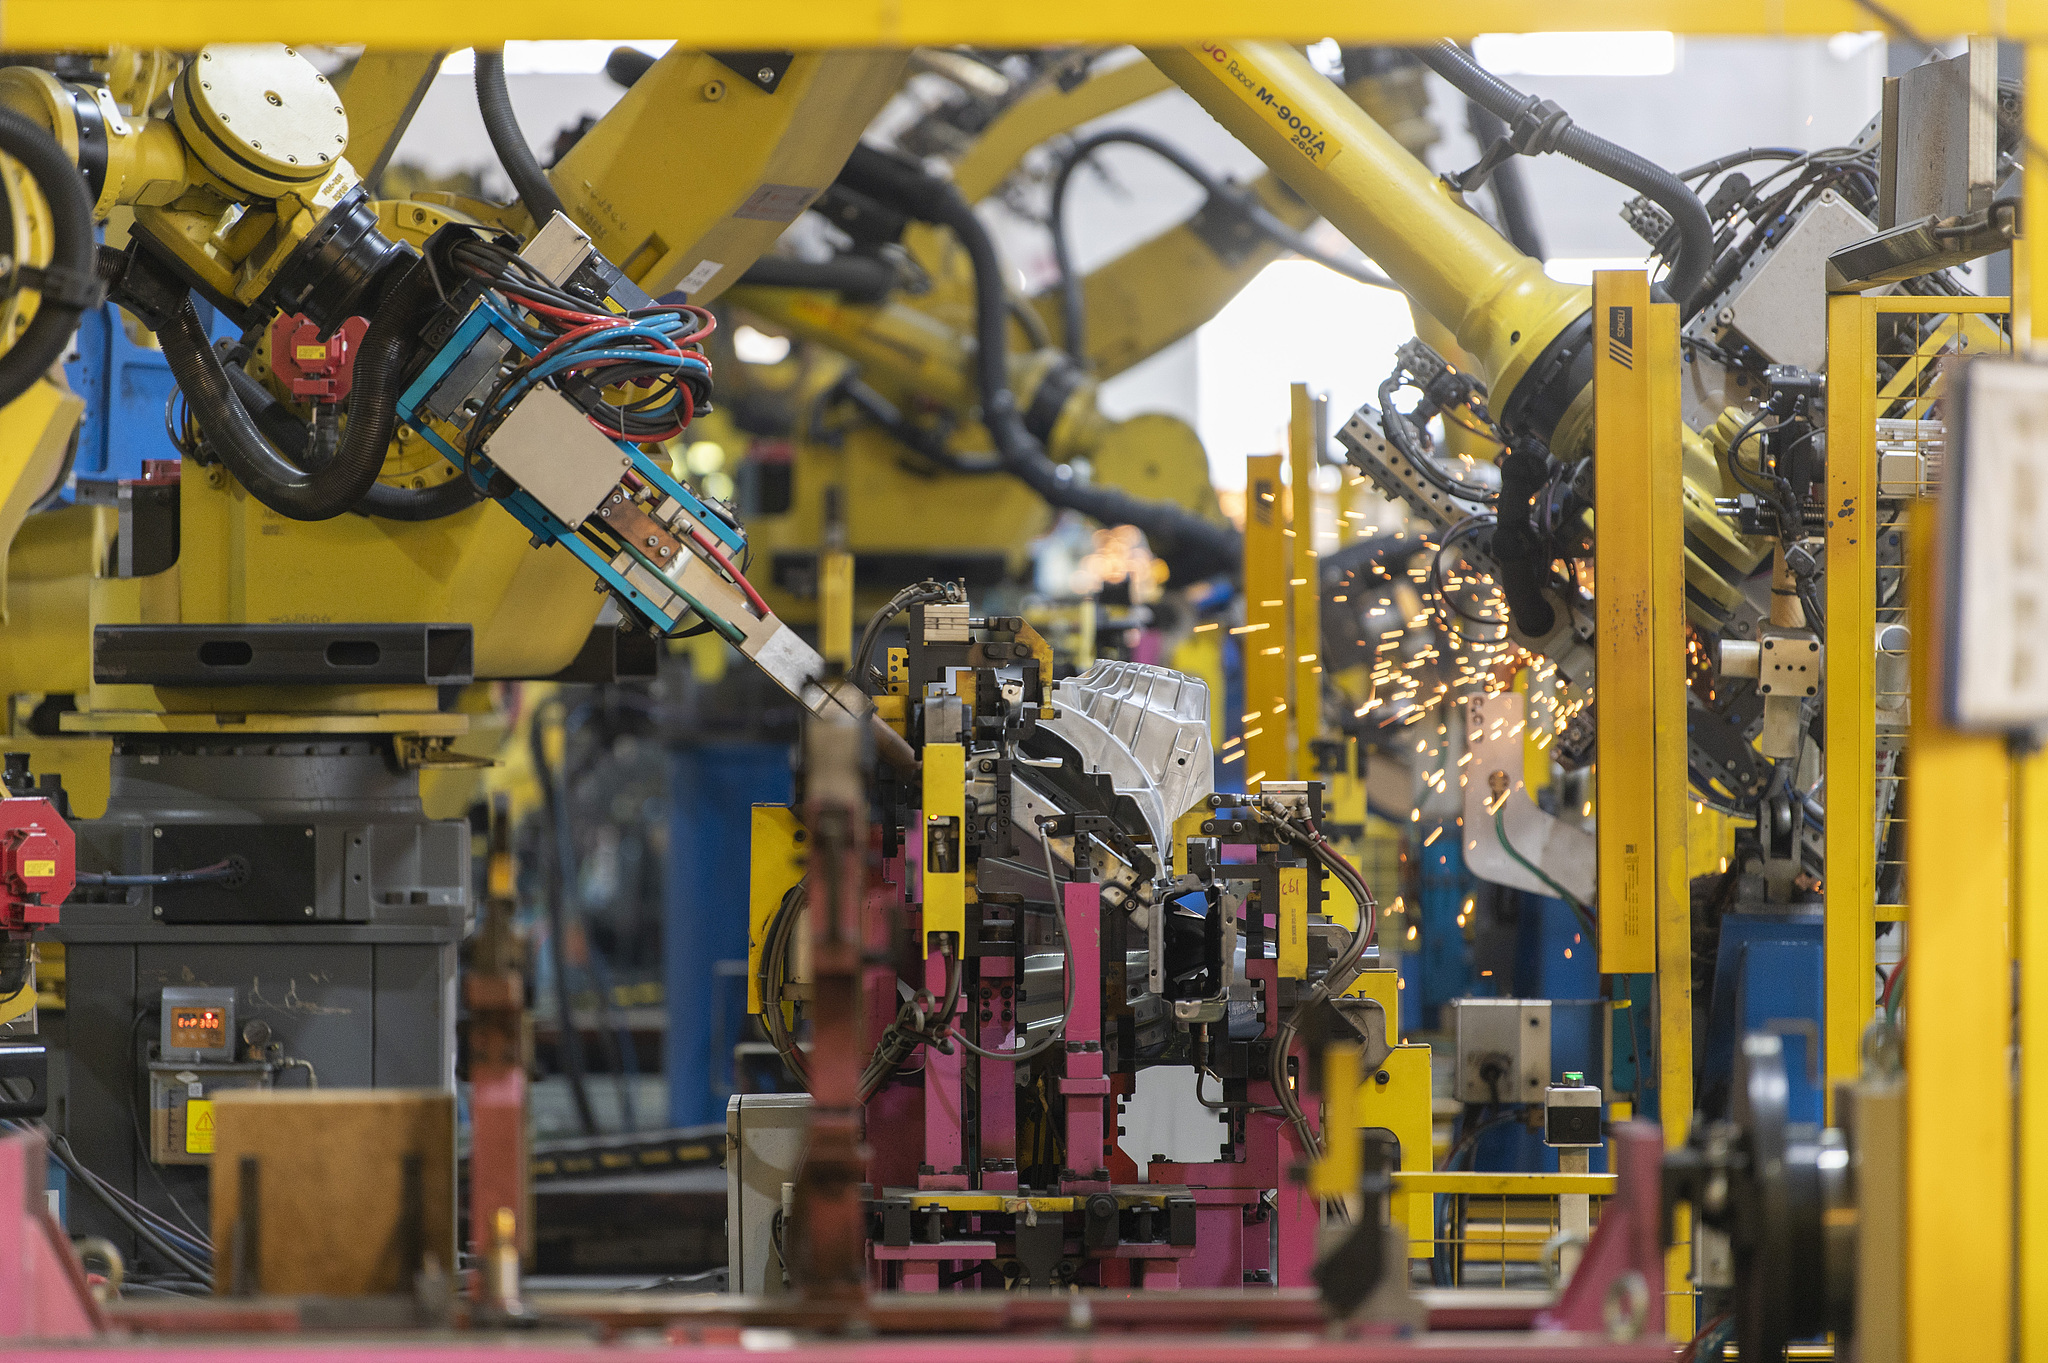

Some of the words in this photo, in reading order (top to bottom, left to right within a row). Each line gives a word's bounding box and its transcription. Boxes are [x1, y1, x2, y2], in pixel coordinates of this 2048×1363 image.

[1226, 59, 1256, 90] Robot
[1256, 87, 1326, 155] M-900iA
[1290, 134, 1317, 163] 260L
